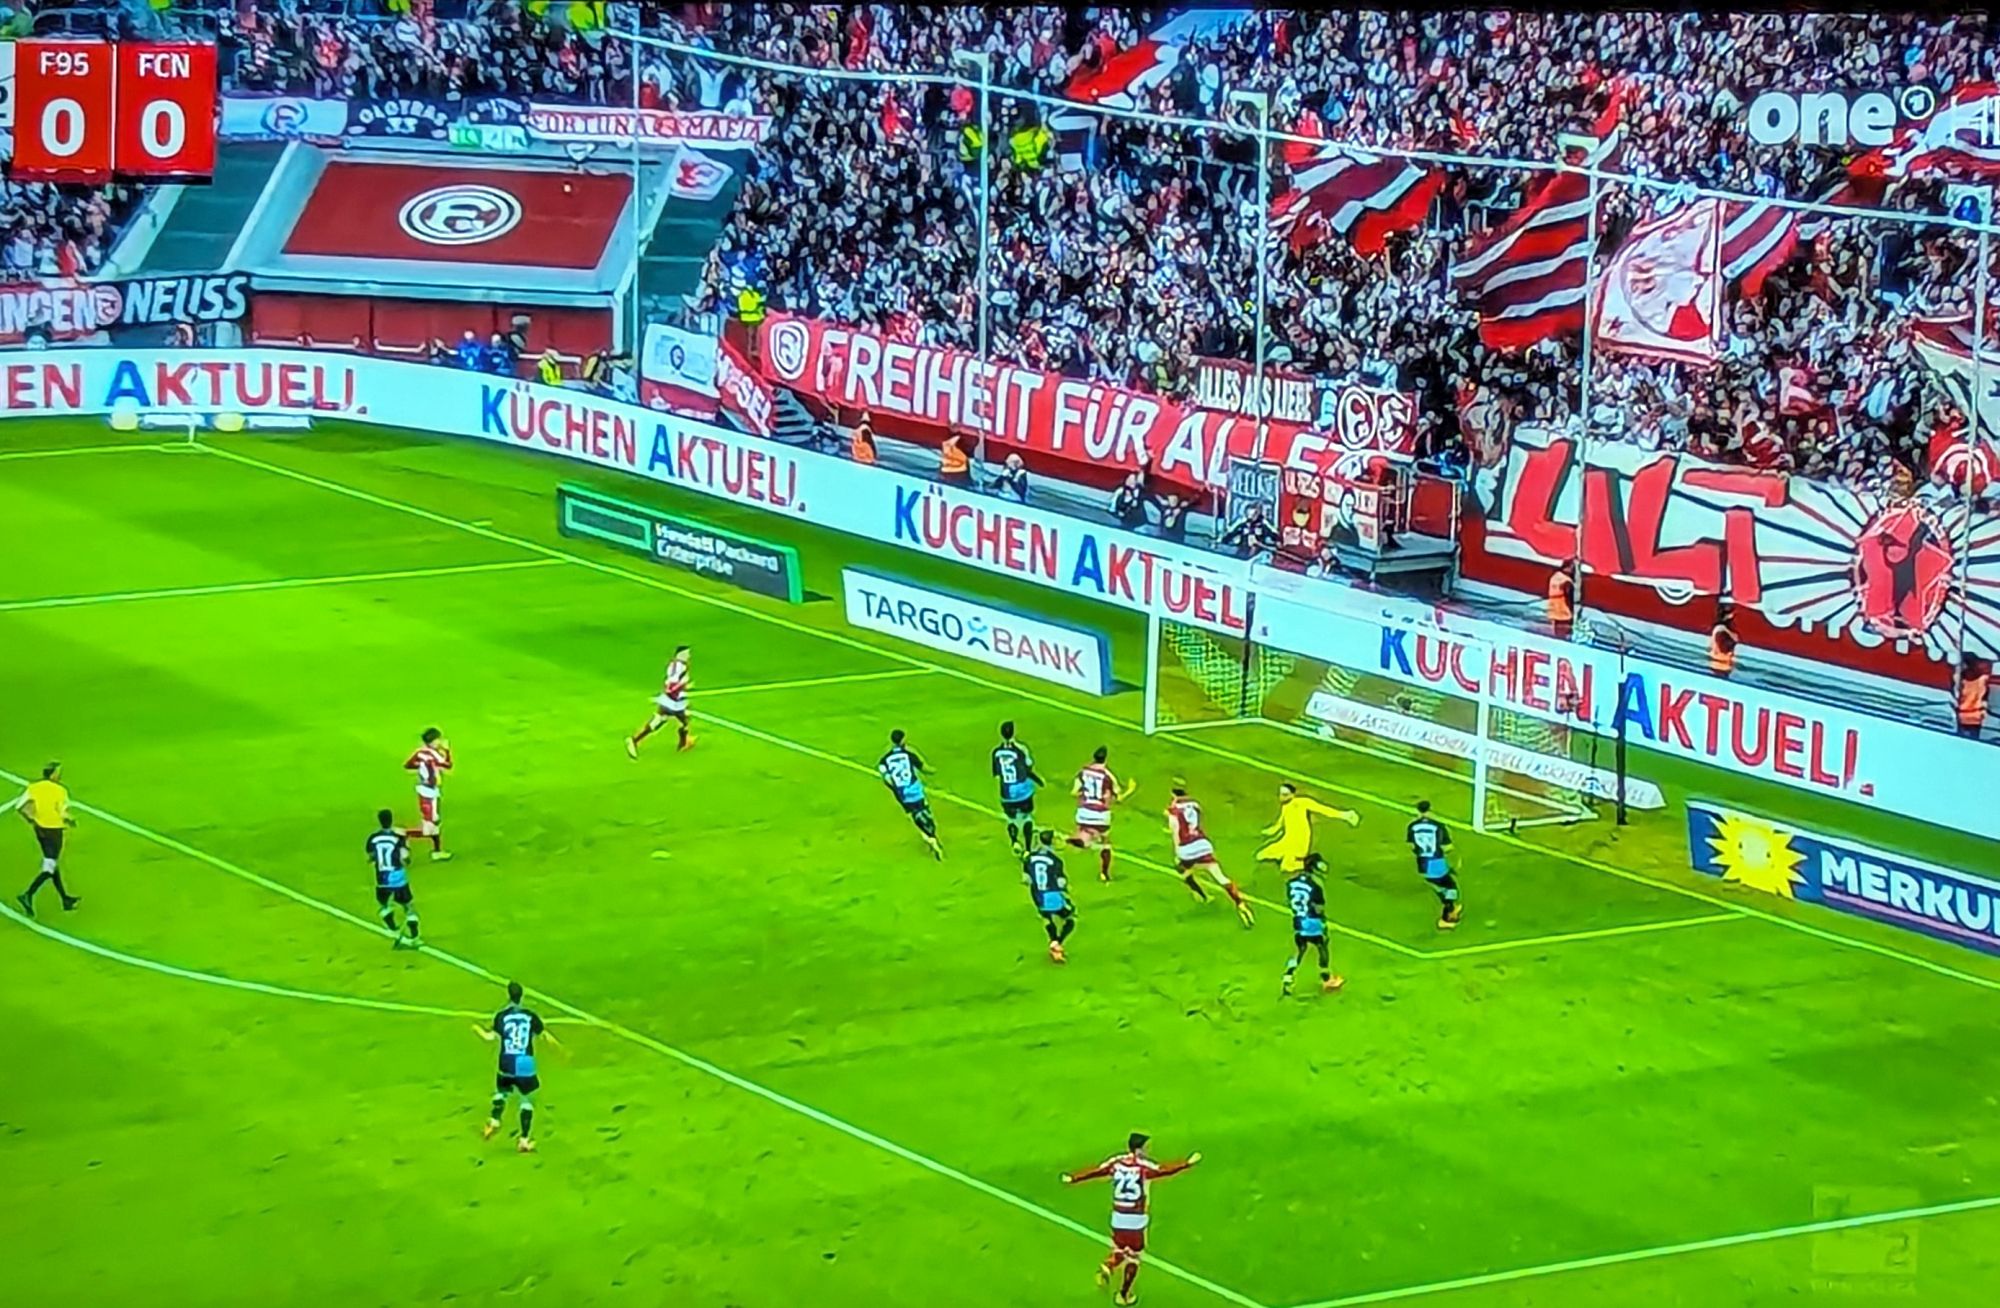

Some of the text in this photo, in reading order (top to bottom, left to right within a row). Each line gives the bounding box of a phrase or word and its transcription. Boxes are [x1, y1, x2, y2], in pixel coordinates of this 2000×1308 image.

[122, 275, 248, 324] NEUSS
[481, 382, 637, 467] KÜCHEN
[816, 329, 1044, 442] FREIHEIT
[1052, 380, 1160, 466] FÜR
[895, 483, 1059, 581] KÜCHEN
[1820, 849, 2000, 935] MERKU
[1113, 1171, 1142, 1200] 23
